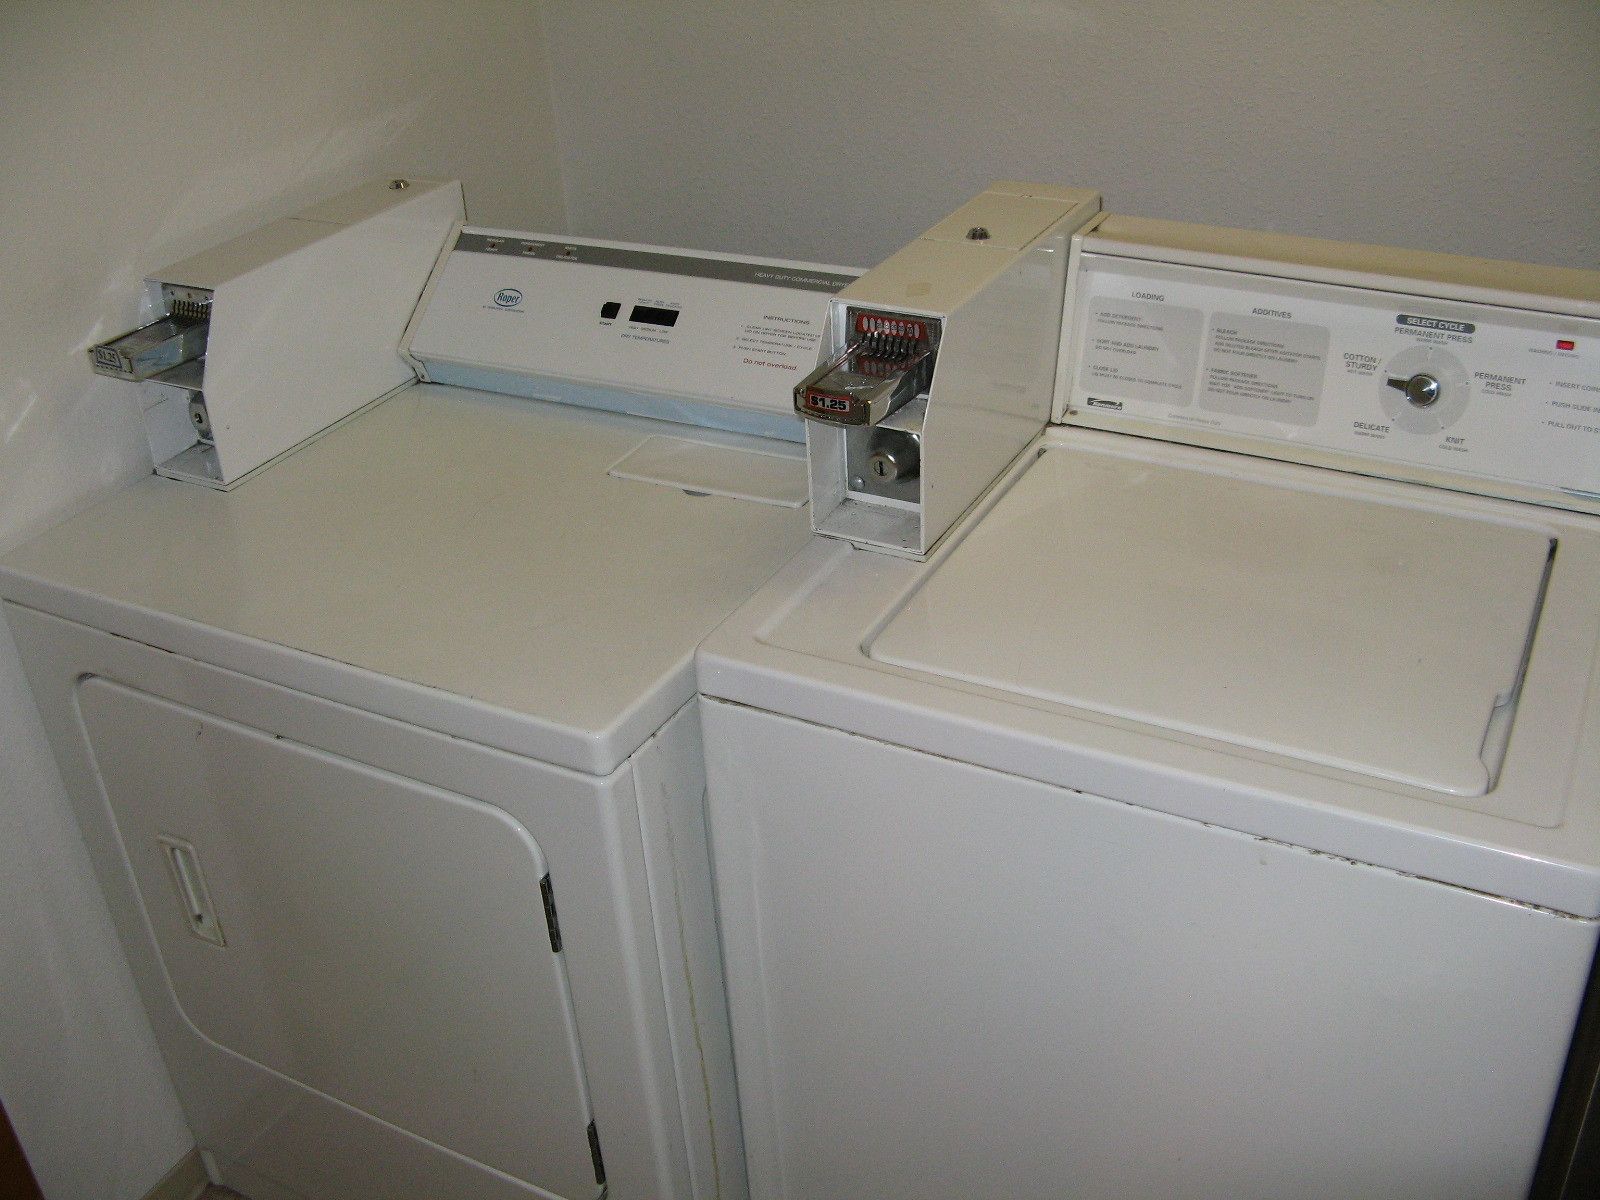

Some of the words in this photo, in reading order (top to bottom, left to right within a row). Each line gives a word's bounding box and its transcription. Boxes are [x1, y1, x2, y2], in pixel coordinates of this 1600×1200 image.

[754, 271, 774, 279] HEAVY
[496, 291, 520, 305] Roper
[1131, 291, 1165, 302] LOADING
[1252, 307, 1292, 319] ADDITIVES
[763, 315, 810, 325] INSTRUCTIONS
[1406, 316, 1436, 328] SELECT
[1438, 321, 1466, 332] CYCLE
[1394, 326, 1446, 340] PERMANENT
[1446, 333, 1473, 344] PRESS
[743, 357, 753, 365] Do
[754, 359, 766, 367] not
[1343, 352, 1377, 364] COTTON
[1345, 361, 1378, 371] STURDY
[1474, 371, 1527, 385] PERMANENT
[1485, 381, 1512, 391] PRESS
[1555, 380, 1580, 389] INSERT
[810, 395, 847, 411] $1.25
[1551, 400, 1571, 408] PUSH
[1353, 421, 1391, 433] DELICATE
[1566, 423, 1581, 431] OUT
[1582, 425, 1592, 433] TO
[1445, 435, 1466, 444] KNIT
